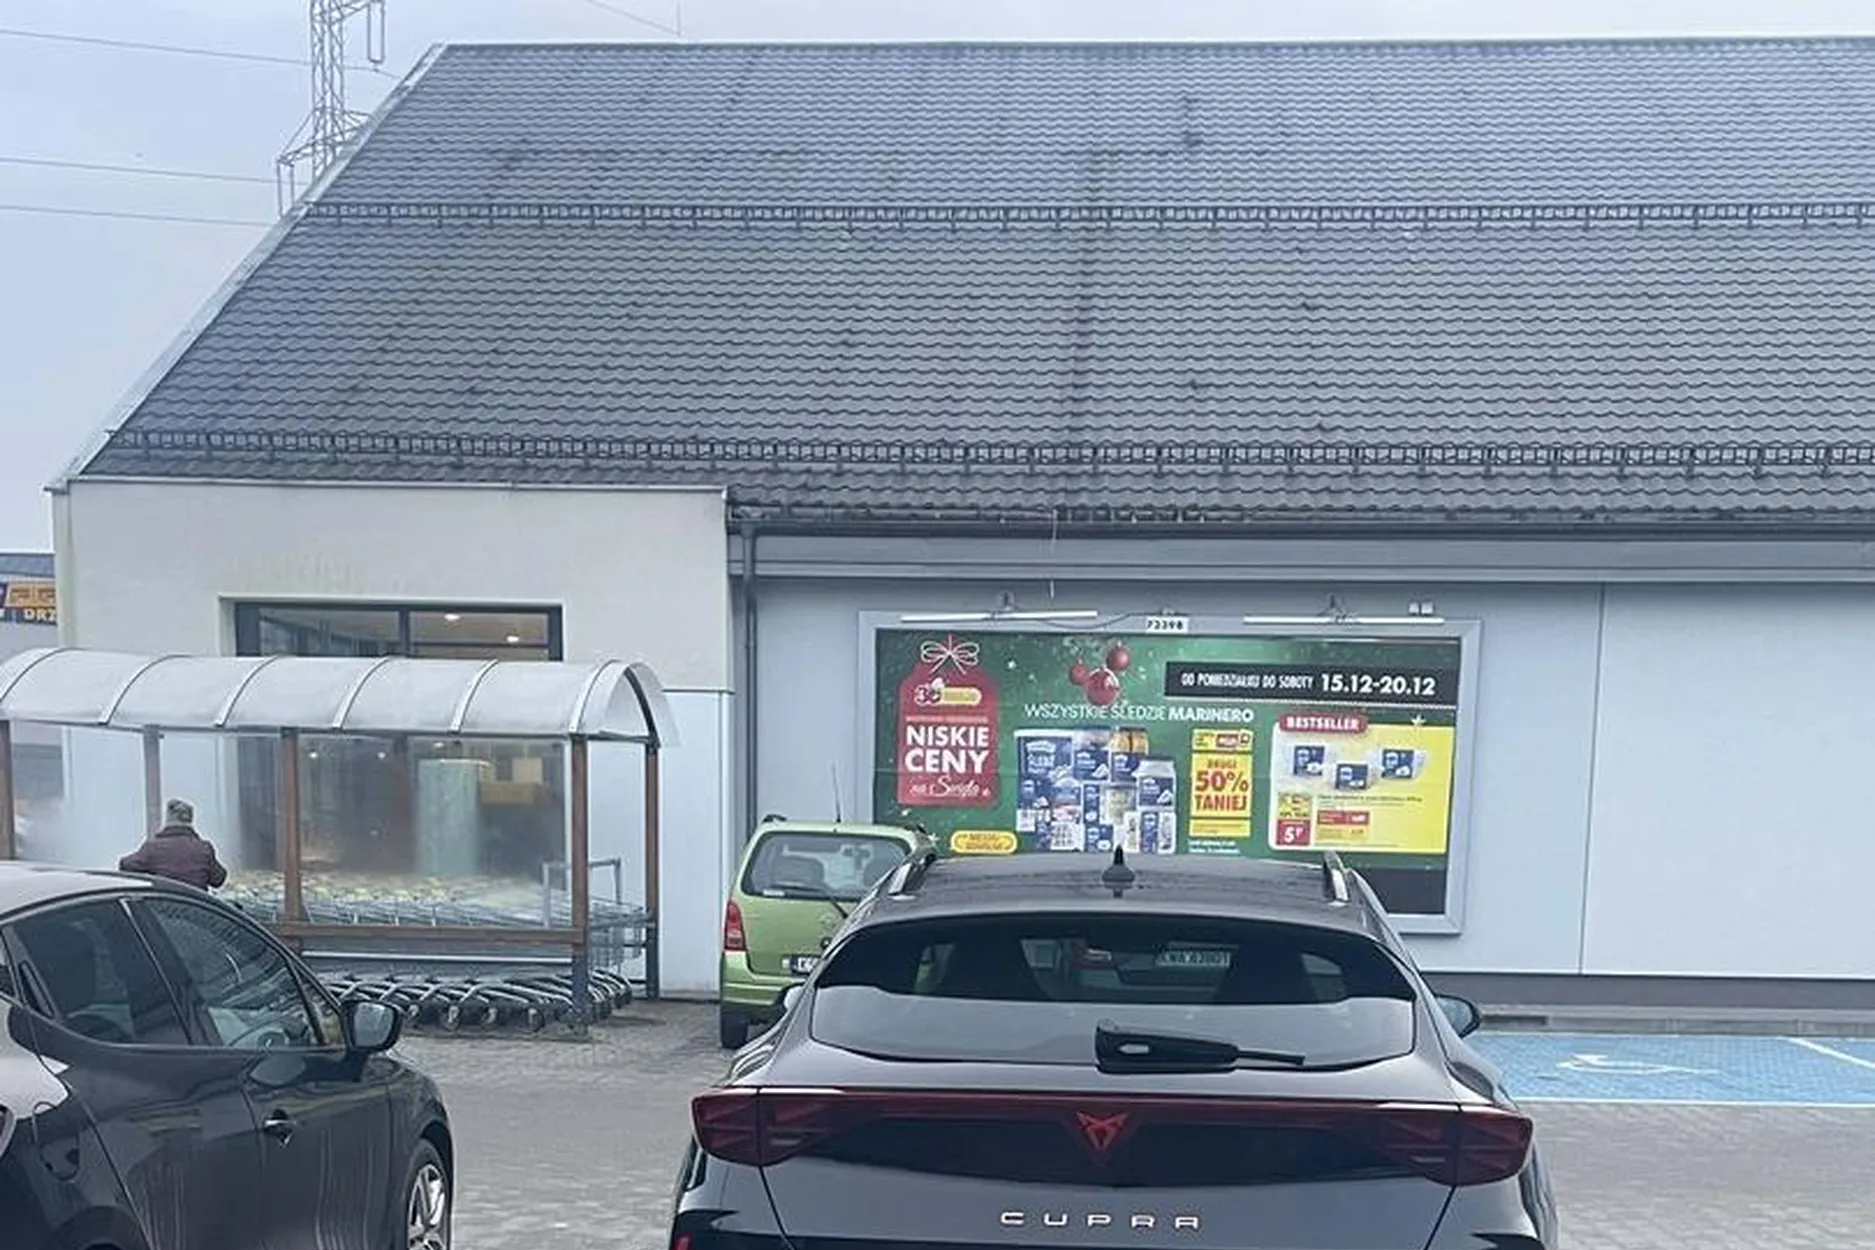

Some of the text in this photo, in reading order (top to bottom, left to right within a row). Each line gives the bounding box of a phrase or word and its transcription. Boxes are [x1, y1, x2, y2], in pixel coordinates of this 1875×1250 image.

[1181, 672, 1196, 687] OD
[1262, 674, 1278, 688] DO
[1279, 674, 1315, 690] SOBOTY
[1321, 673, 1435, 696] 15.12-20.12
[1024, 703, 1108, 719] WSZYSTKIE
[1168, 705, 1254, 723] MARINERO
[1286, 716, 1360, 730] BESTSELLER
[906, 725, 989, 747] NISKIE
[904, 748, 990, 774] CENY
[1195, 771, 1249, 793] 50%
[1195, 795, 1247, 812] TANIEJ
[1000, 1211, 1200, 1229] CUPRA
